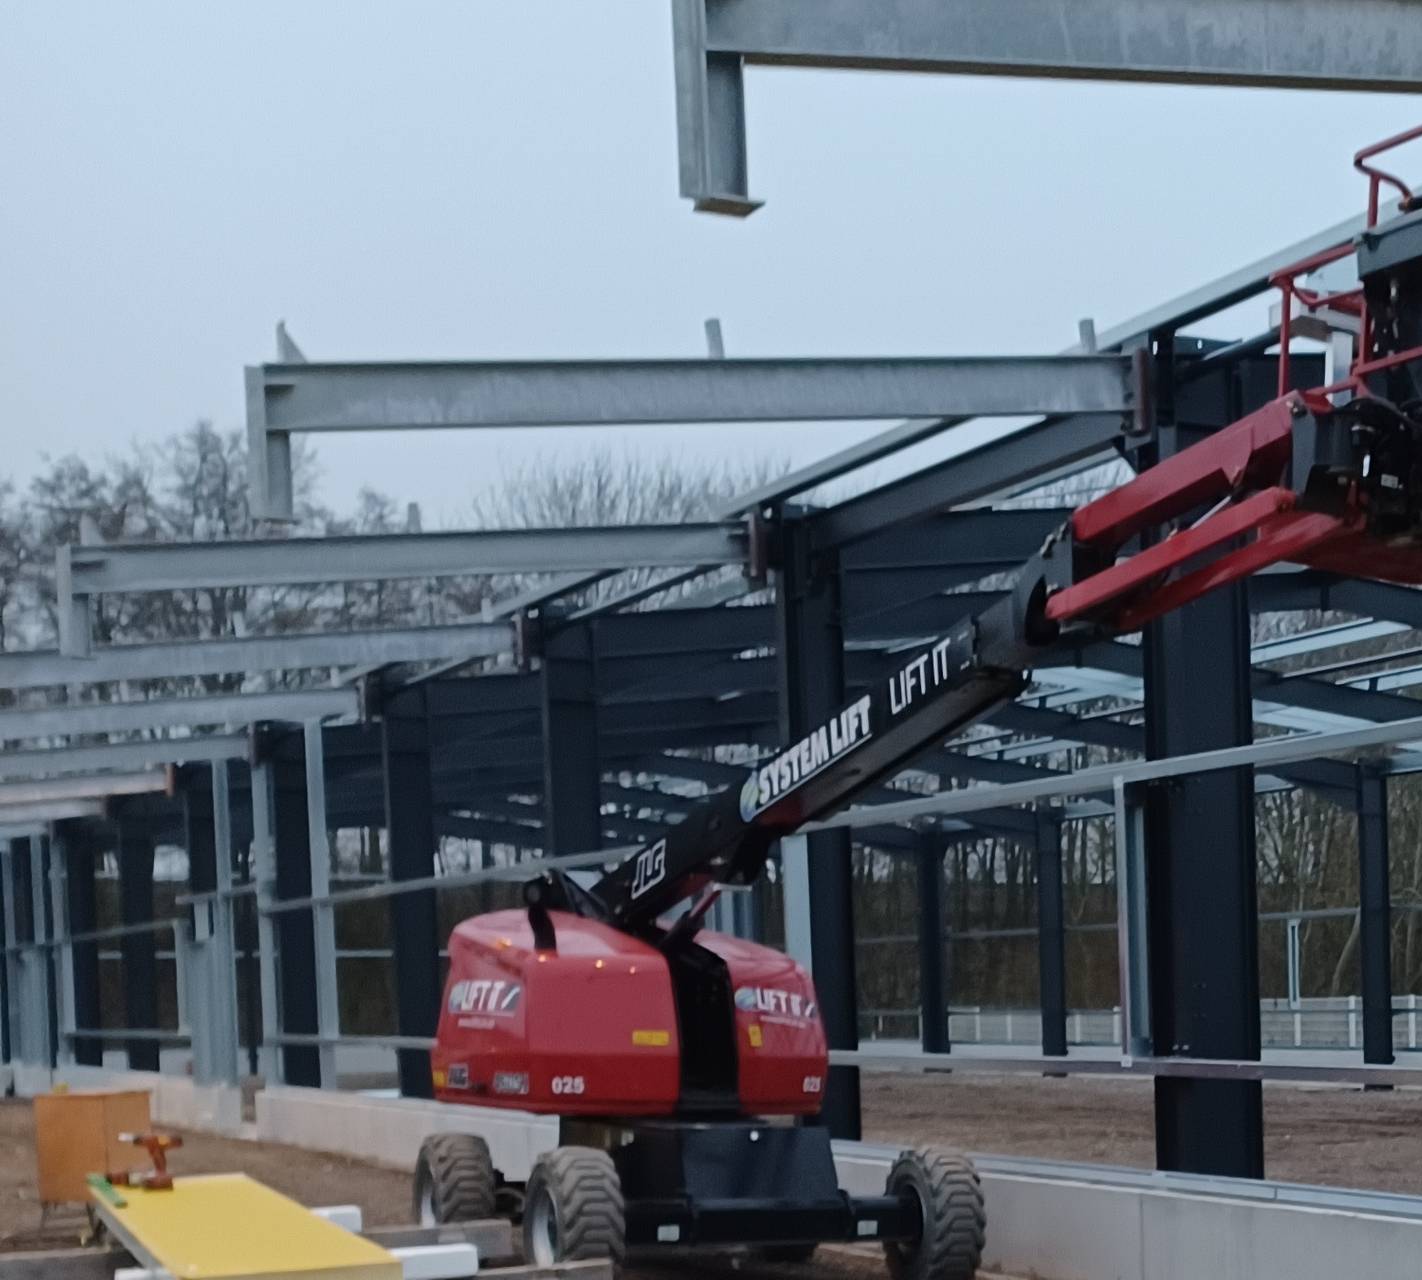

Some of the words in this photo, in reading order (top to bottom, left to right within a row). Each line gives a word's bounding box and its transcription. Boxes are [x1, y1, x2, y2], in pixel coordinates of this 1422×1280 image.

[889, 653, 928, 715] LIFT
[932, 637, 951, 686] IT
[759, 725, 829, 805] SYSTEM
[830, 694, 871, 756] LIFT
[631, 838, 666, 900] JLG
[461, 981, 492, 1011] LIFT
[756, 987, 788, 1013] LIFT
[551, 1076, 584, 1094] 025
